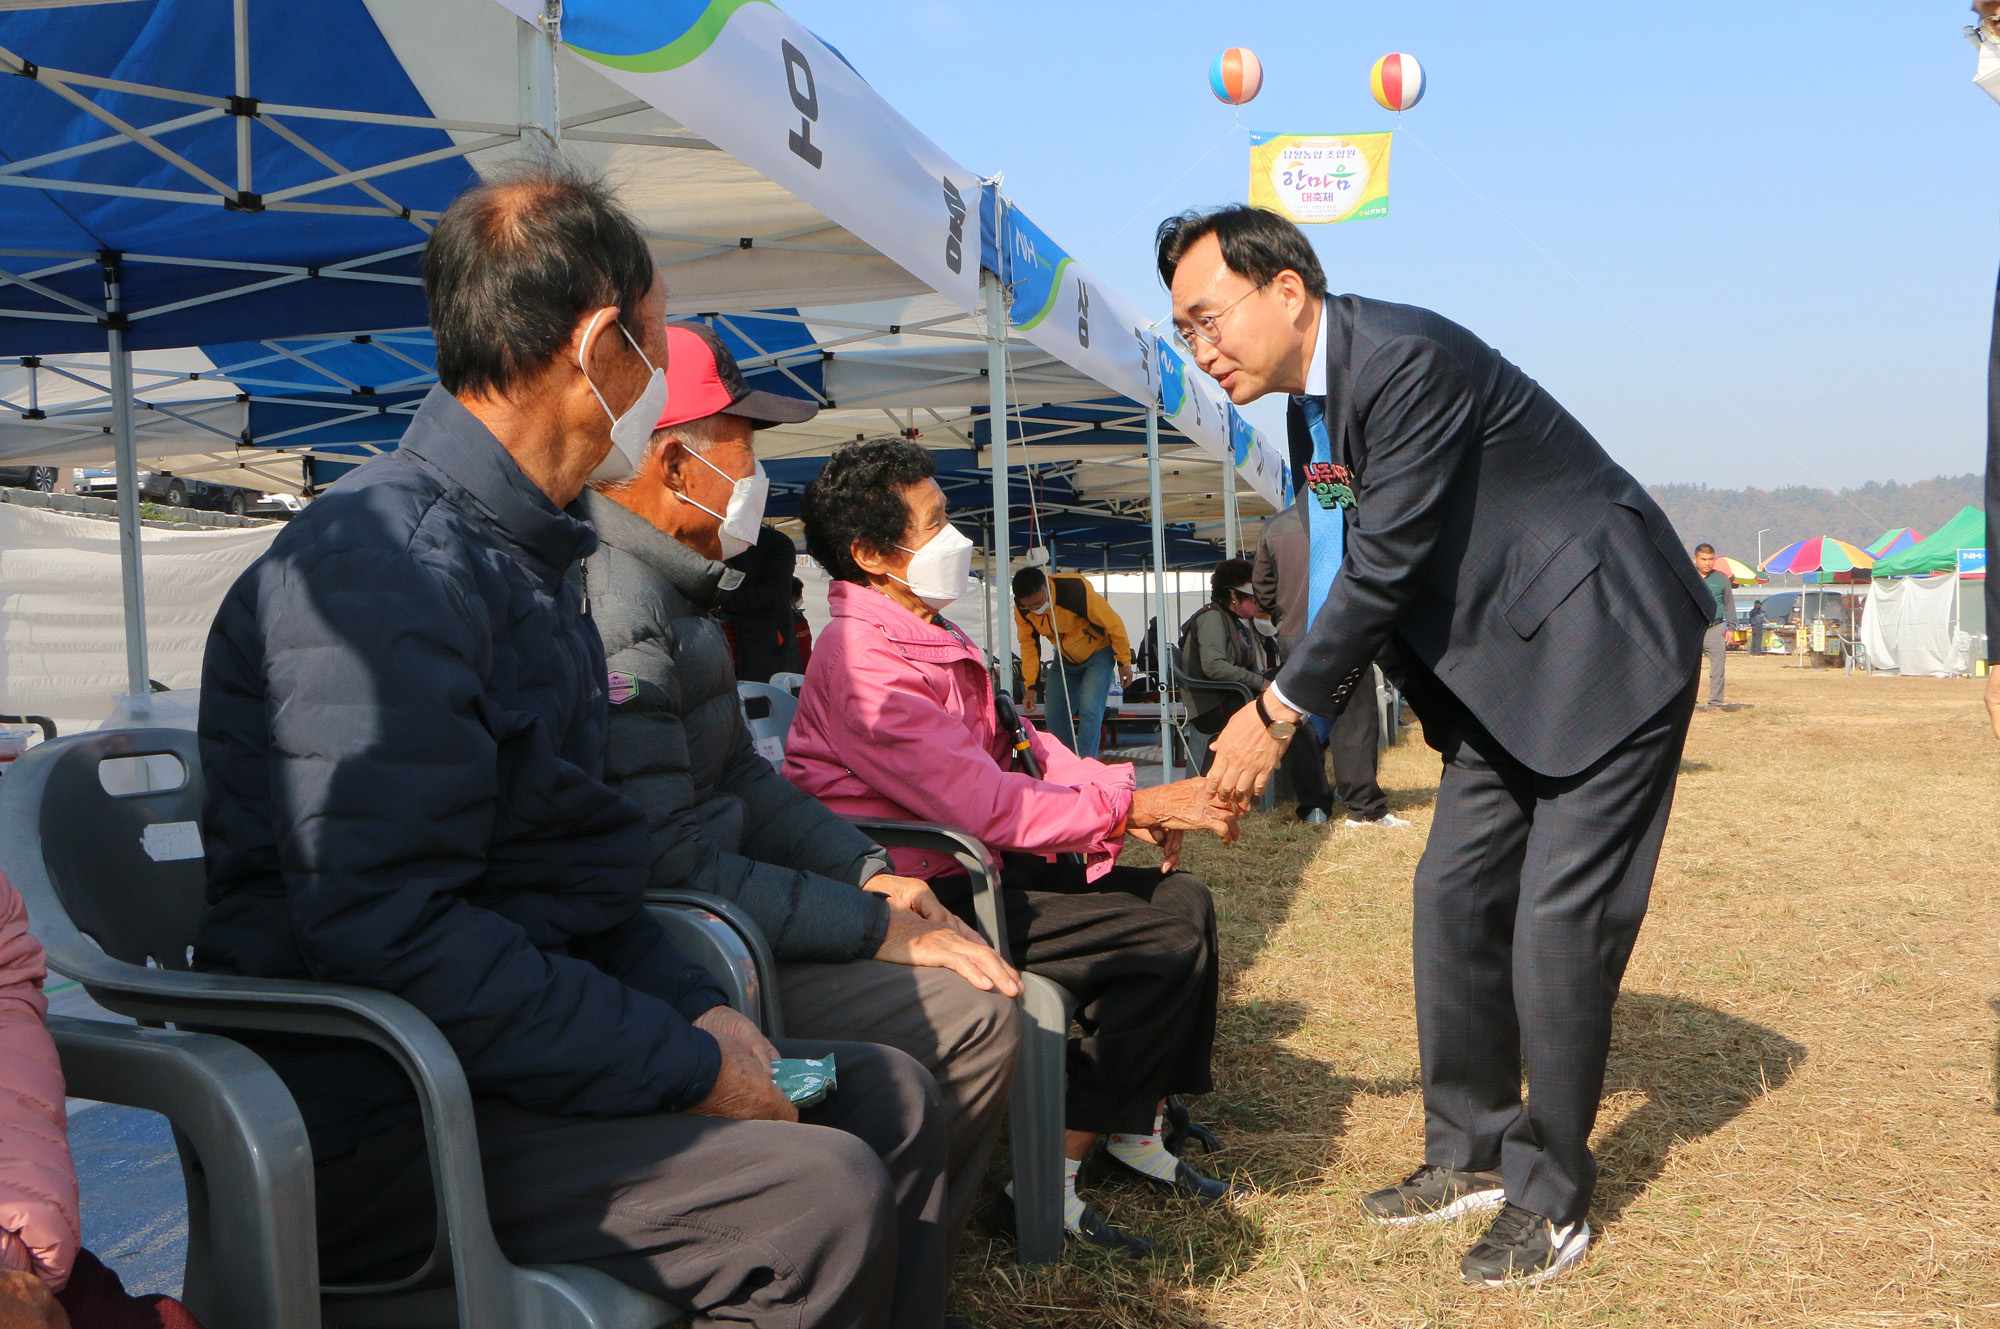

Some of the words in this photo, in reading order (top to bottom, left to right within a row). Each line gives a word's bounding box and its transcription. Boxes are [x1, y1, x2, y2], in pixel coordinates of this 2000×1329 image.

[1283, 150, 1323, 160] 남평농협
[1325, 149, 1356, 159] 조합원
[1282, 161, 1358, 191] 한마음
[1302, 192, 1334, 203] 대축제
[1015, 226, 1038, 269] NH
[1962, 552, 1982, 560] NH
